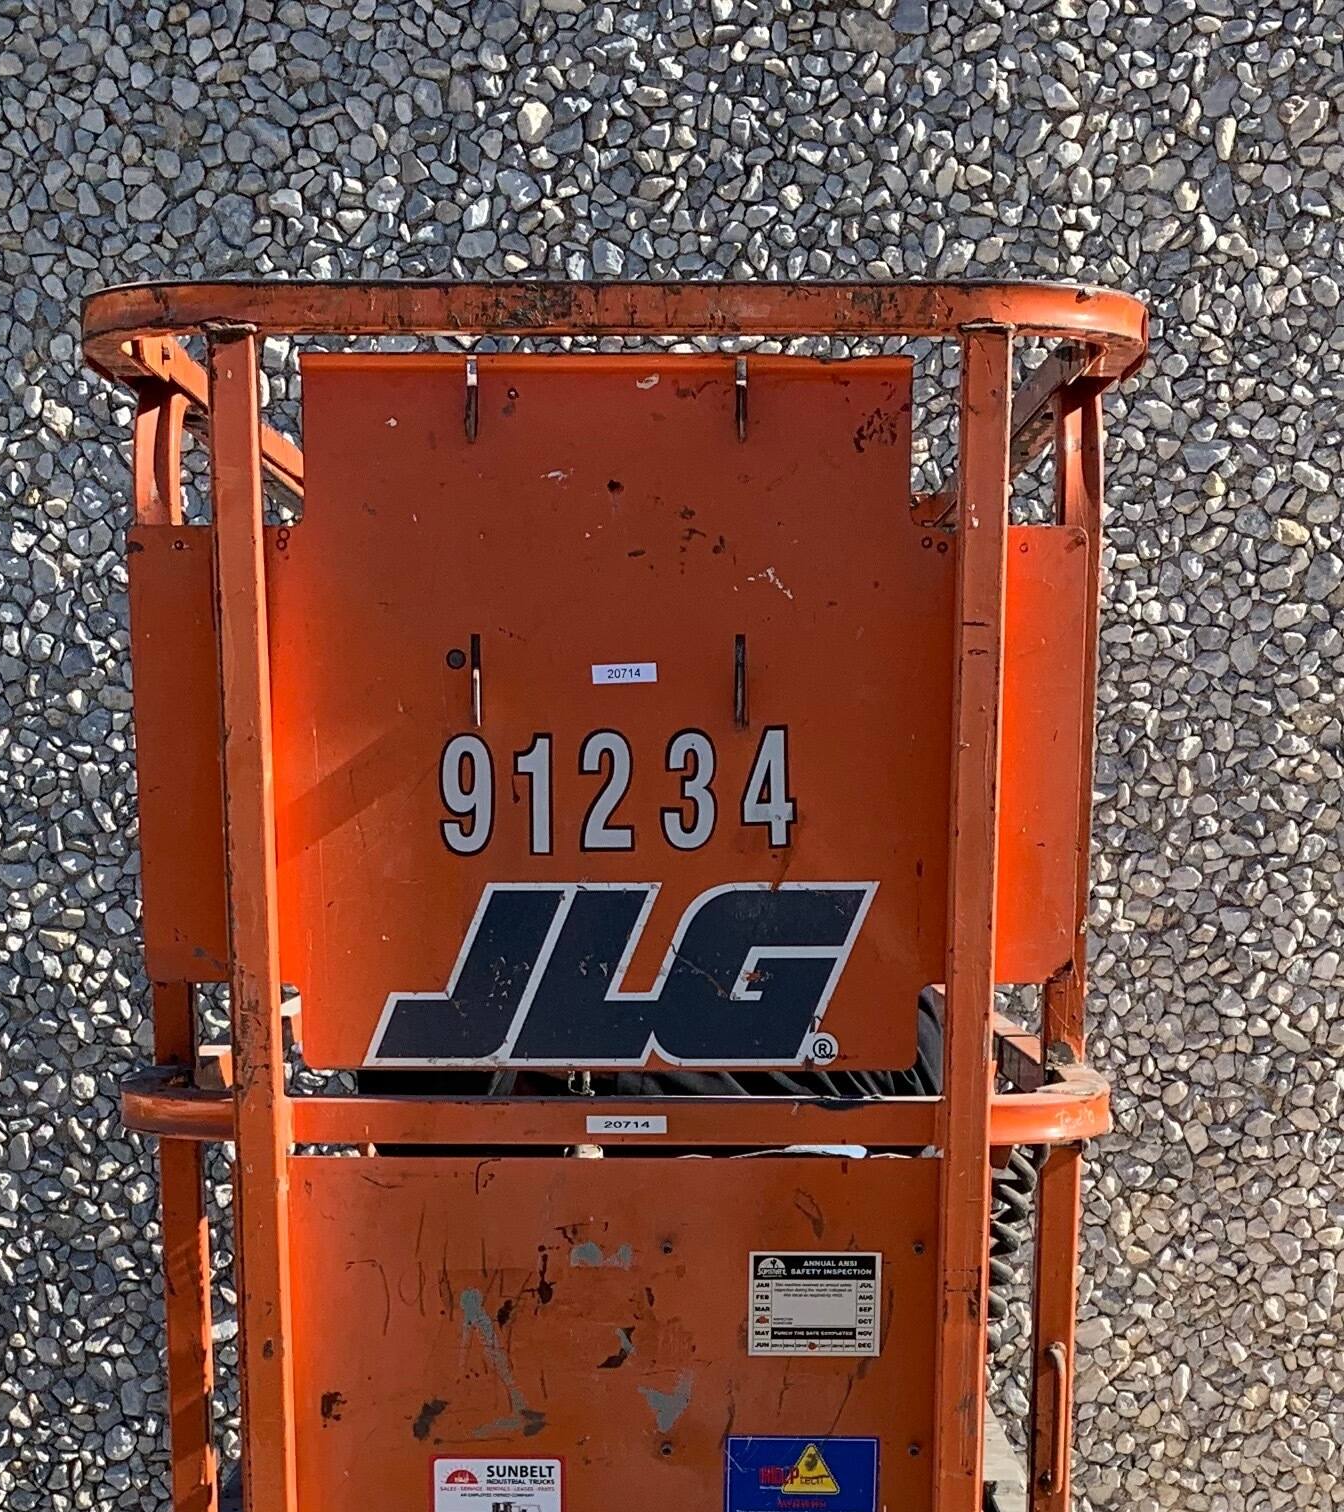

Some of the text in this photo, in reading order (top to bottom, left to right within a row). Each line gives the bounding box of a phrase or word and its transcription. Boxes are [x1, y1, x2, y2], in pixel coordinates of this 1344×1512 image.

[607, 668, 641, 679] 20714
[439, 725, 797, 855] 91234
[362, 881, 880, 1066] JLG
[604, 1121, 650, 1129] 20714
[486, 1465, 555, 1478] SUNBELT
